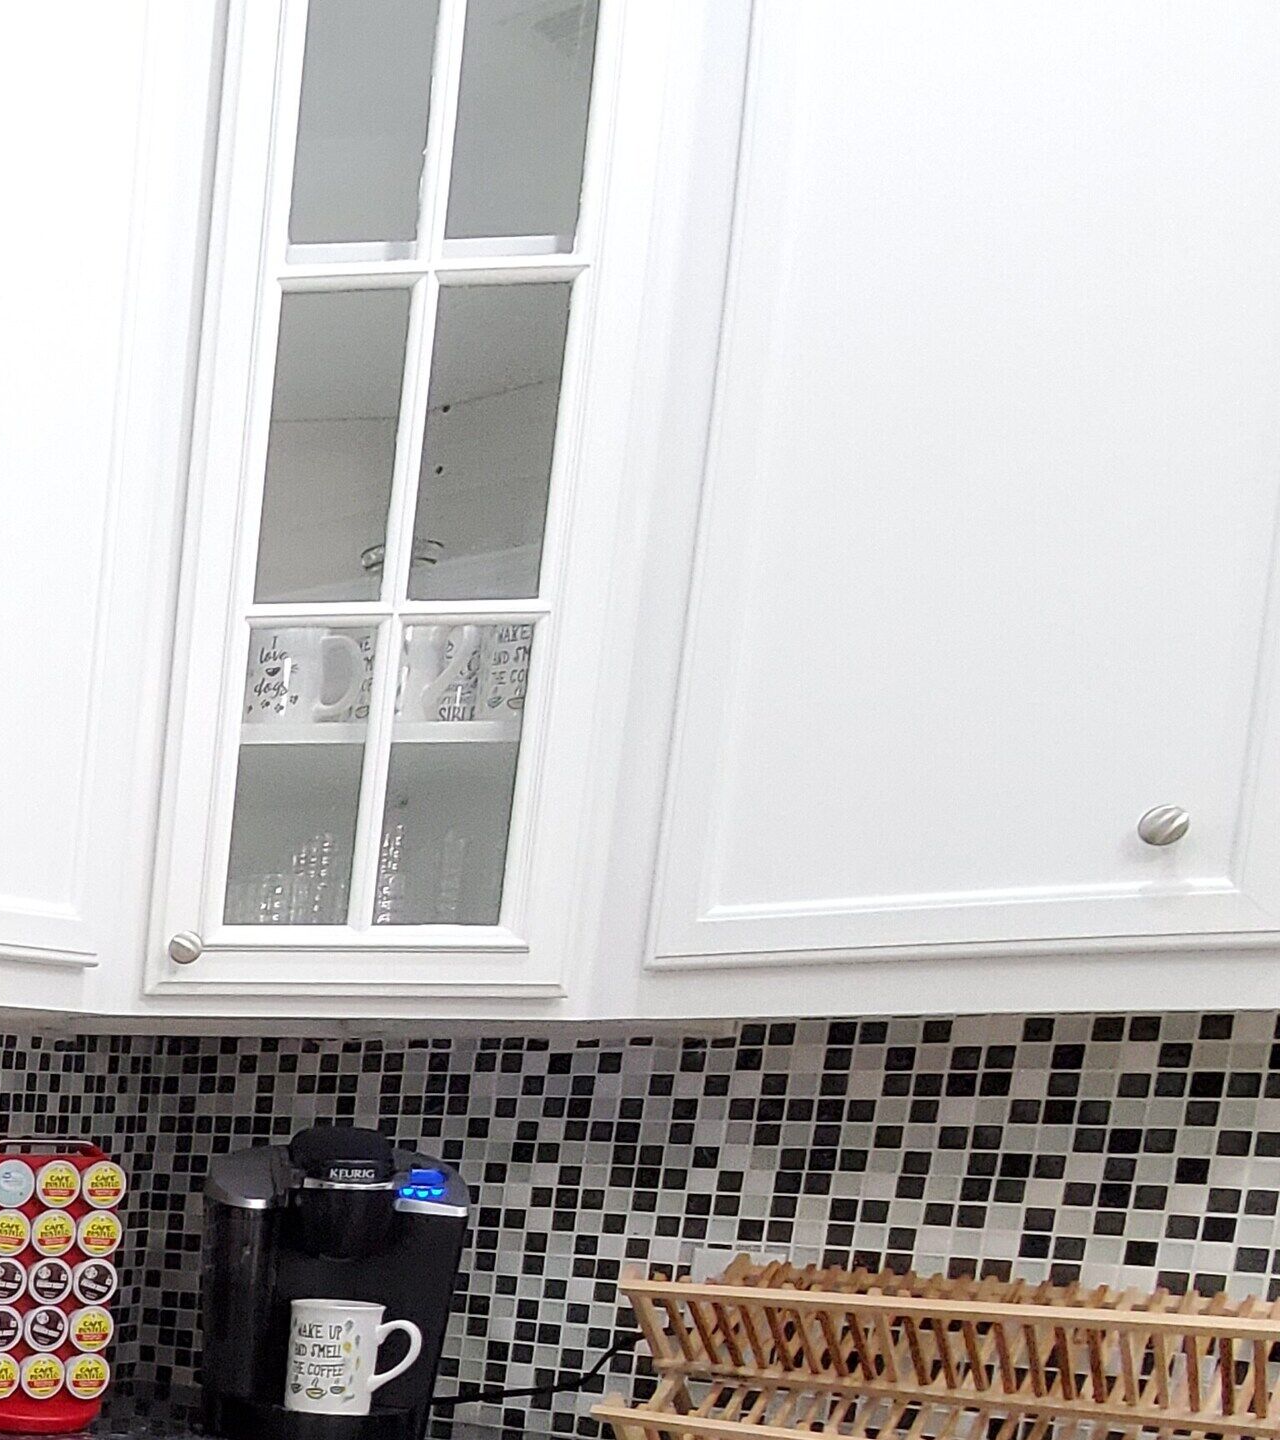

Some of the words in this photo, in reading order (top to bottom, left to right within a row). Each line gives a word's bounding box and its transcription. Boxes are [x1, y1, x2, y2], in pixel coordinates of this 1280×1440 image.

[260, 647, 288, 664] love
[254, 678, 288, 699] dogs
[330, 1168, 375, 1180] KEURIG
[329, 1325, 343, 1340] UP
[311, 1343, 342, 1358] SMELL
[307, 1362, 345, 1378] COFFEE
